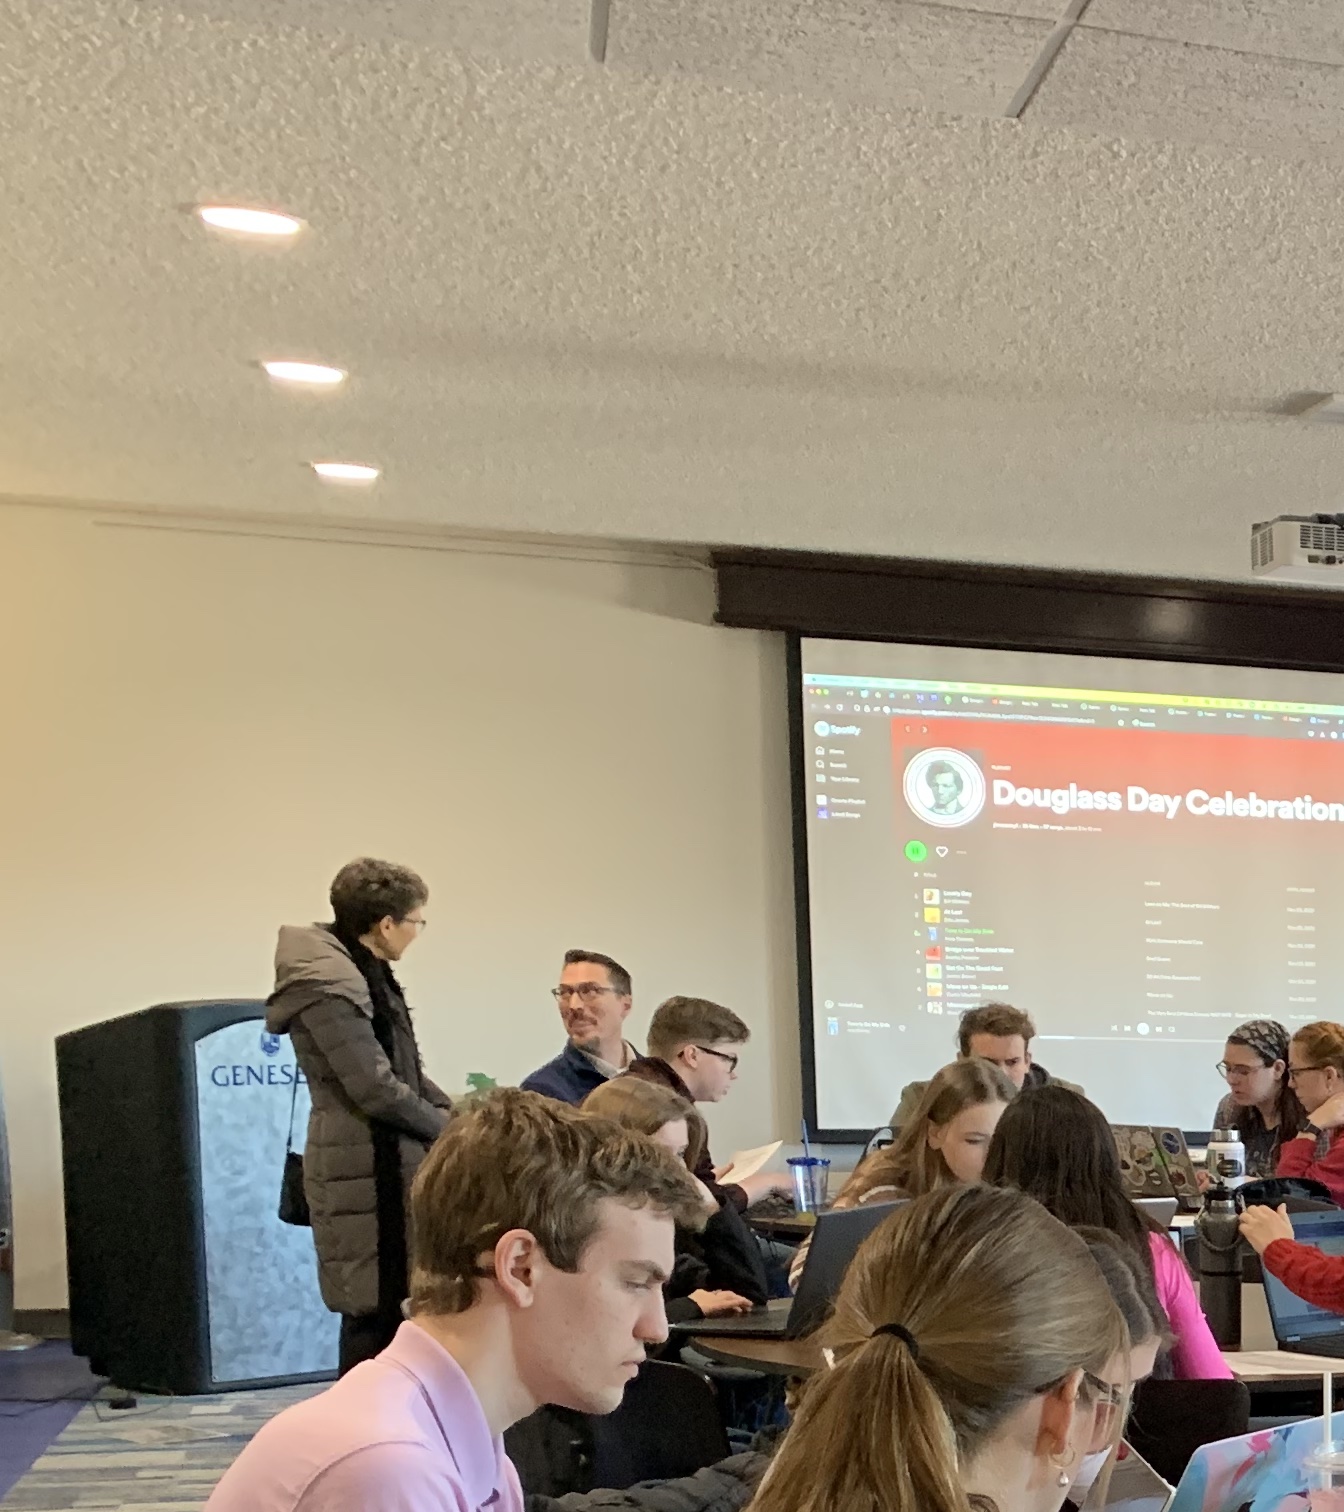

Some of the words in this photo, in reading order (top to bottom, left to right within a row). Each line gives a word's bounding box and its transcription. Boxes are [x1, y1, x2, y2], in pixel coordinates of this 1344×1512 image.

[830, 724, 861, 736] Spotify
[992, 779, 1122, 815] Douglass
[1127, 785, 1182, 818] Day
[211, 1064, 308, 1087] GENESE
